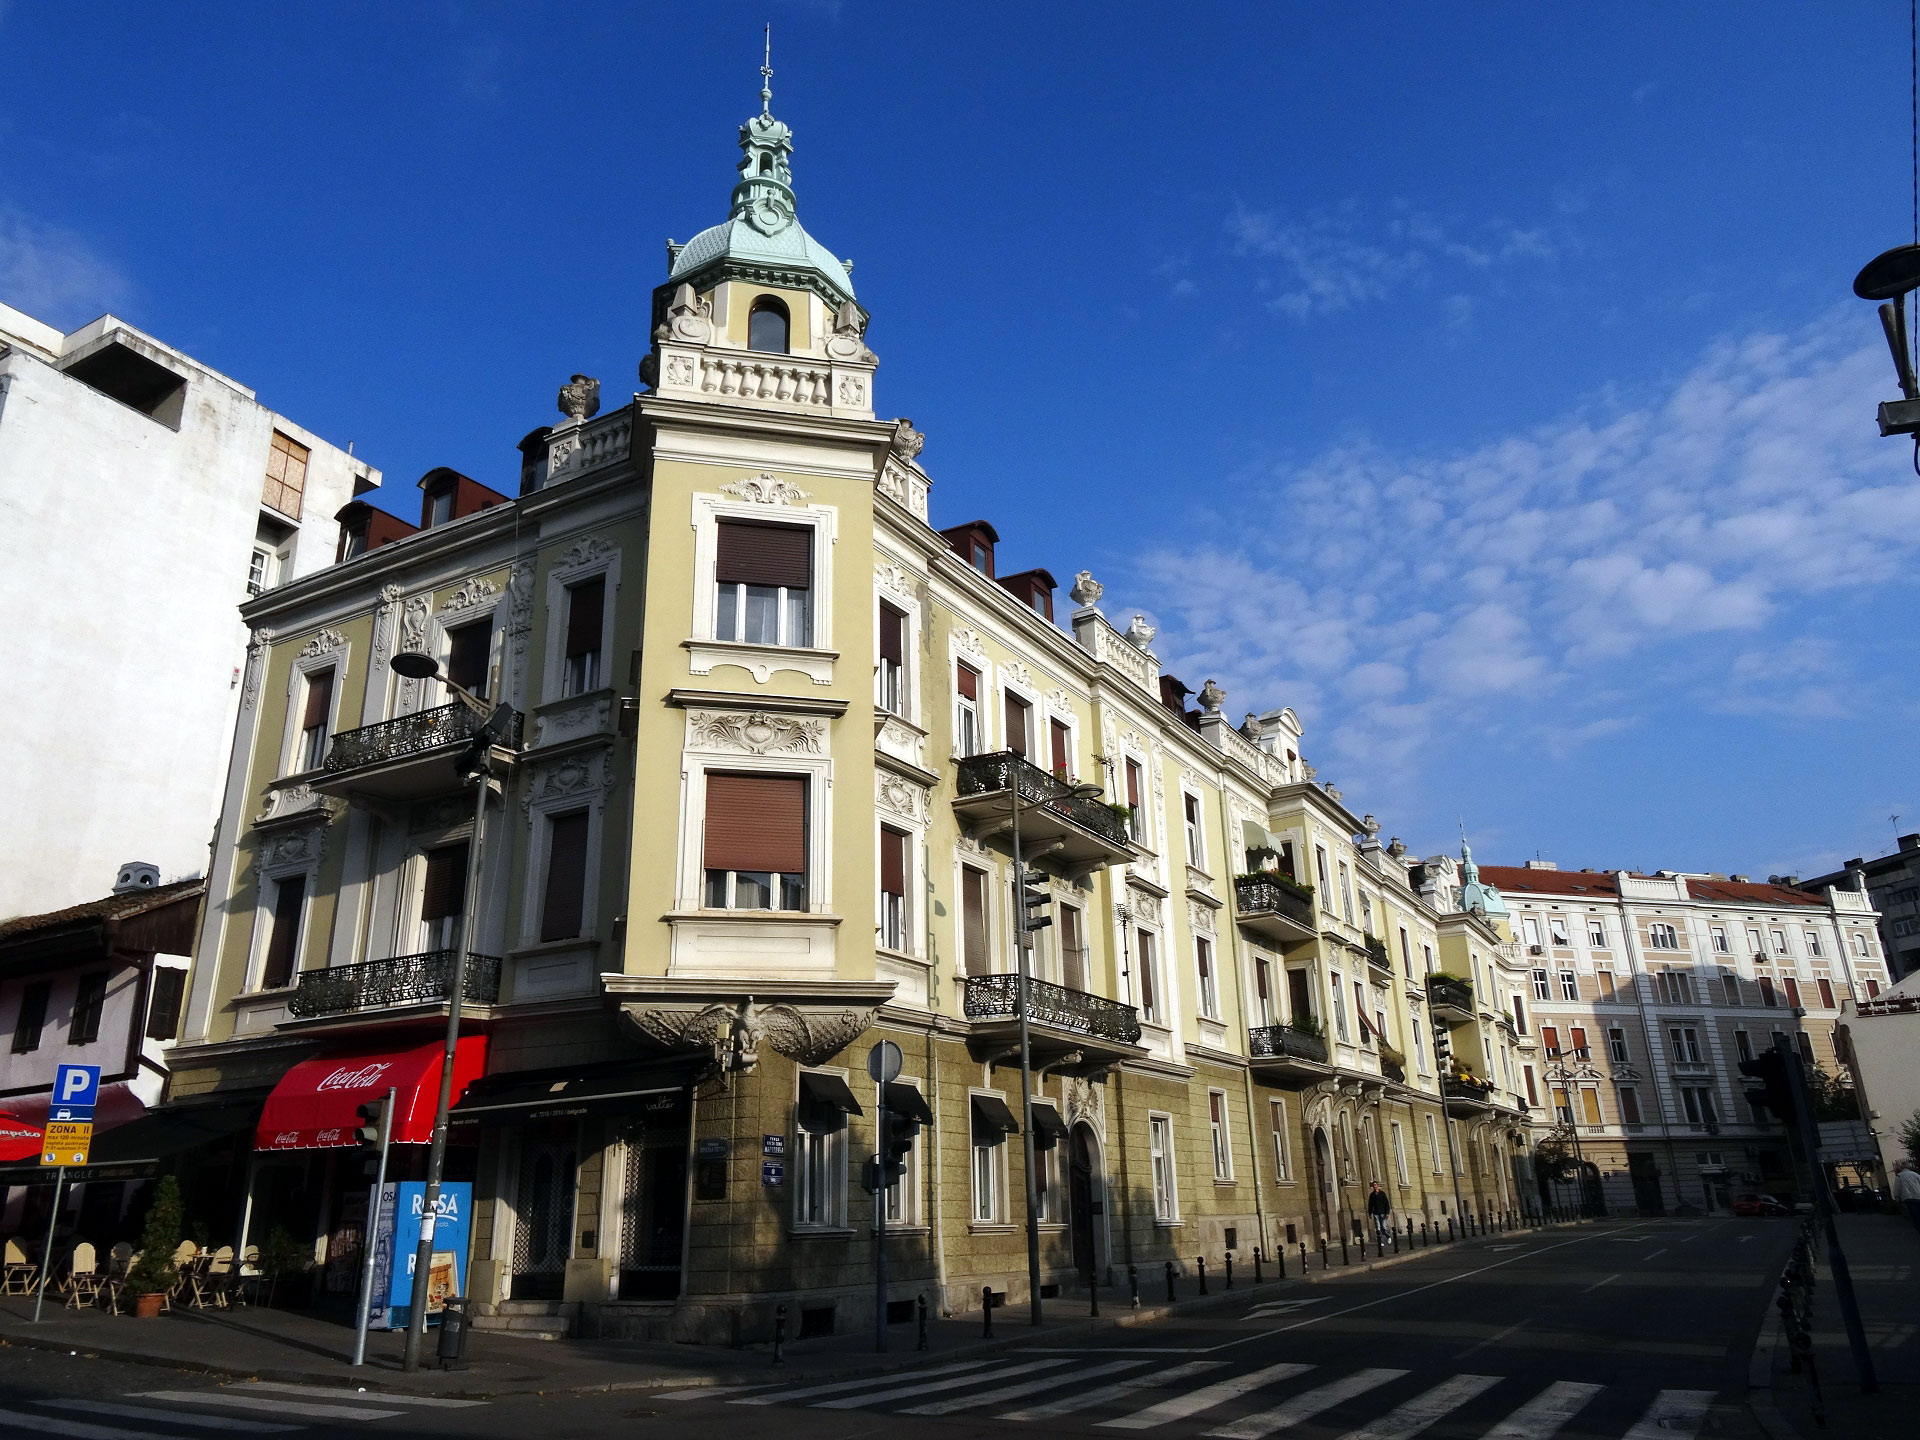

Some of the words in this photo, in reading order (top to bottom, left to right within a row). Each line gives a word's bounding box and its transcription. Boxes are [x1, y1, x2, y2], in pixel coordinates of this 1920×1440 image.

[316, 1062, 393, 1092] Coca-Cola
[62, 1069, 90, 1101] P
[50, 1126, 76, 1134] ZONA
[316, 1128, 342, 1142] Coca-Cola
[274, 1131, 300, 1144] Coca-Cola
[46, 1169, 94, 1180] TRANGLE
[412, 1193, 458, 1214] RSA
